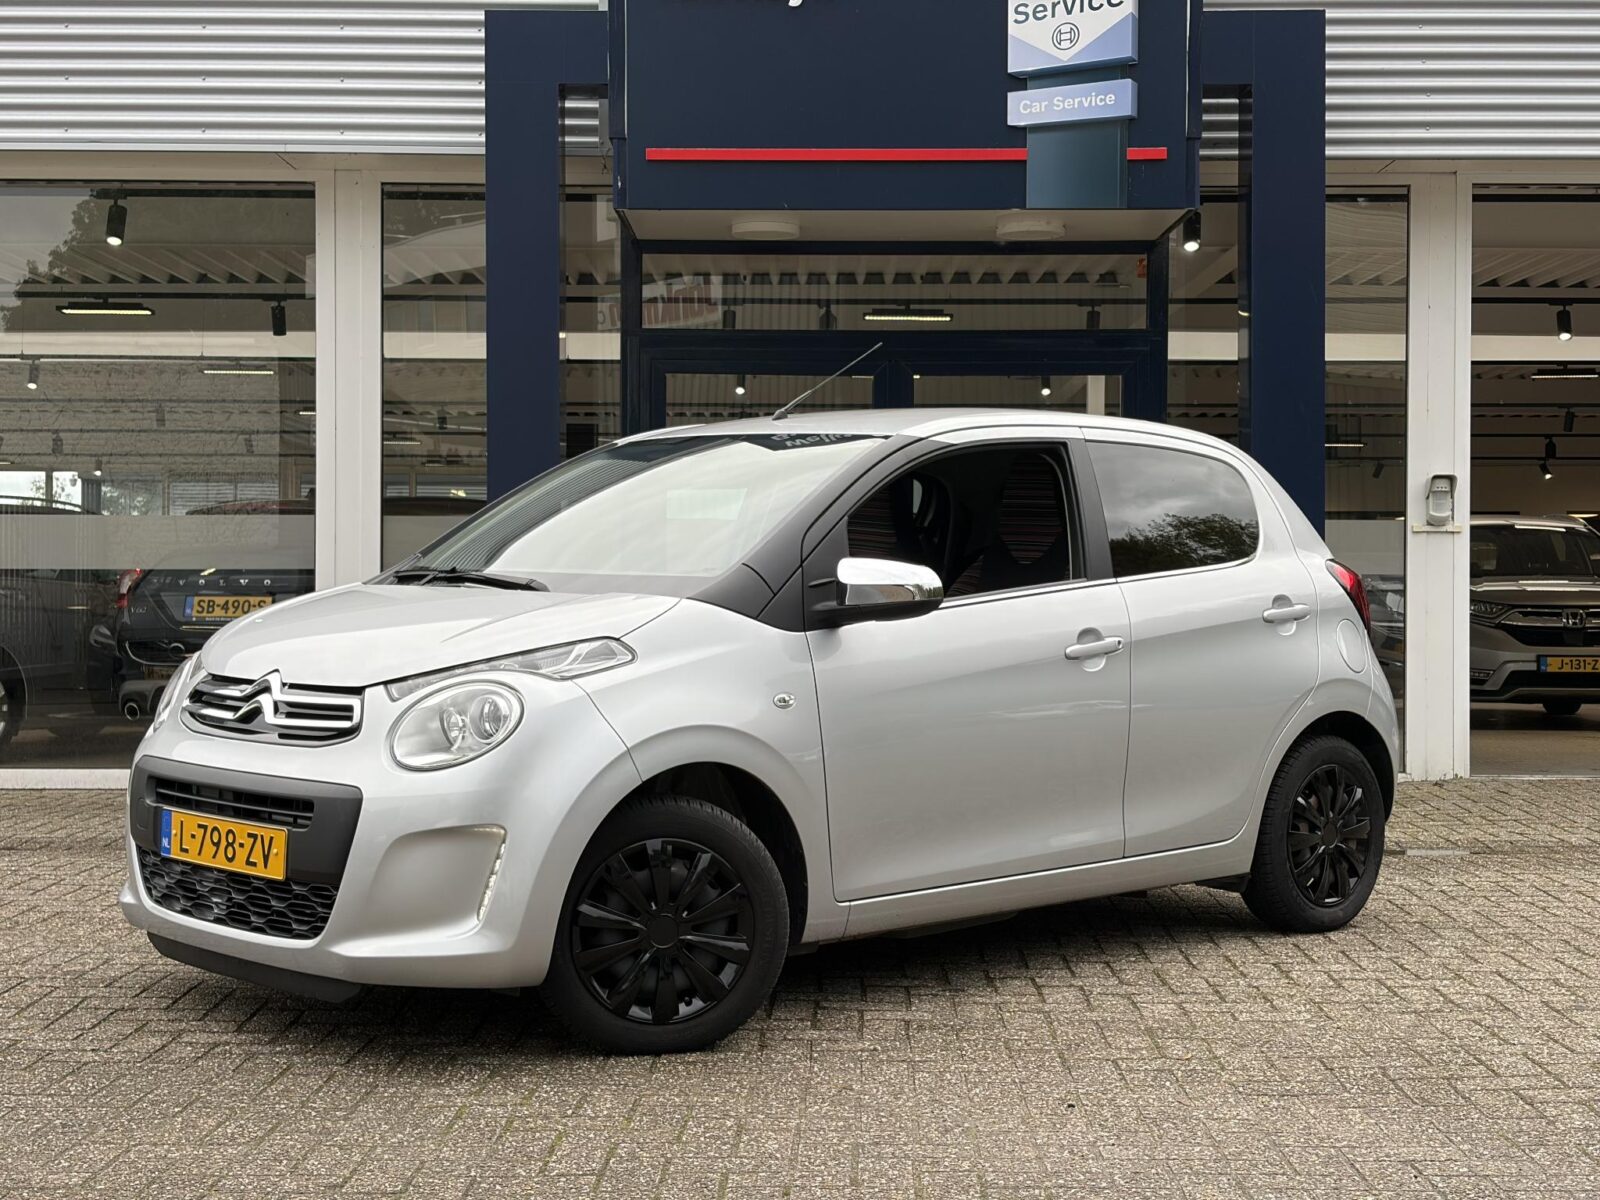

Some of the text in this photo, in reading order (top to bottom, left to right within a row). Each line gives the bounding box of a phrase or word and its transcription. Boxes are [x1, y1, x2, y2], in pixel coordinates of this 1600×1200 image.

[1019, 92, 1116, 114] Car Service
[179, 817, 275, 870] L-798-ZV
